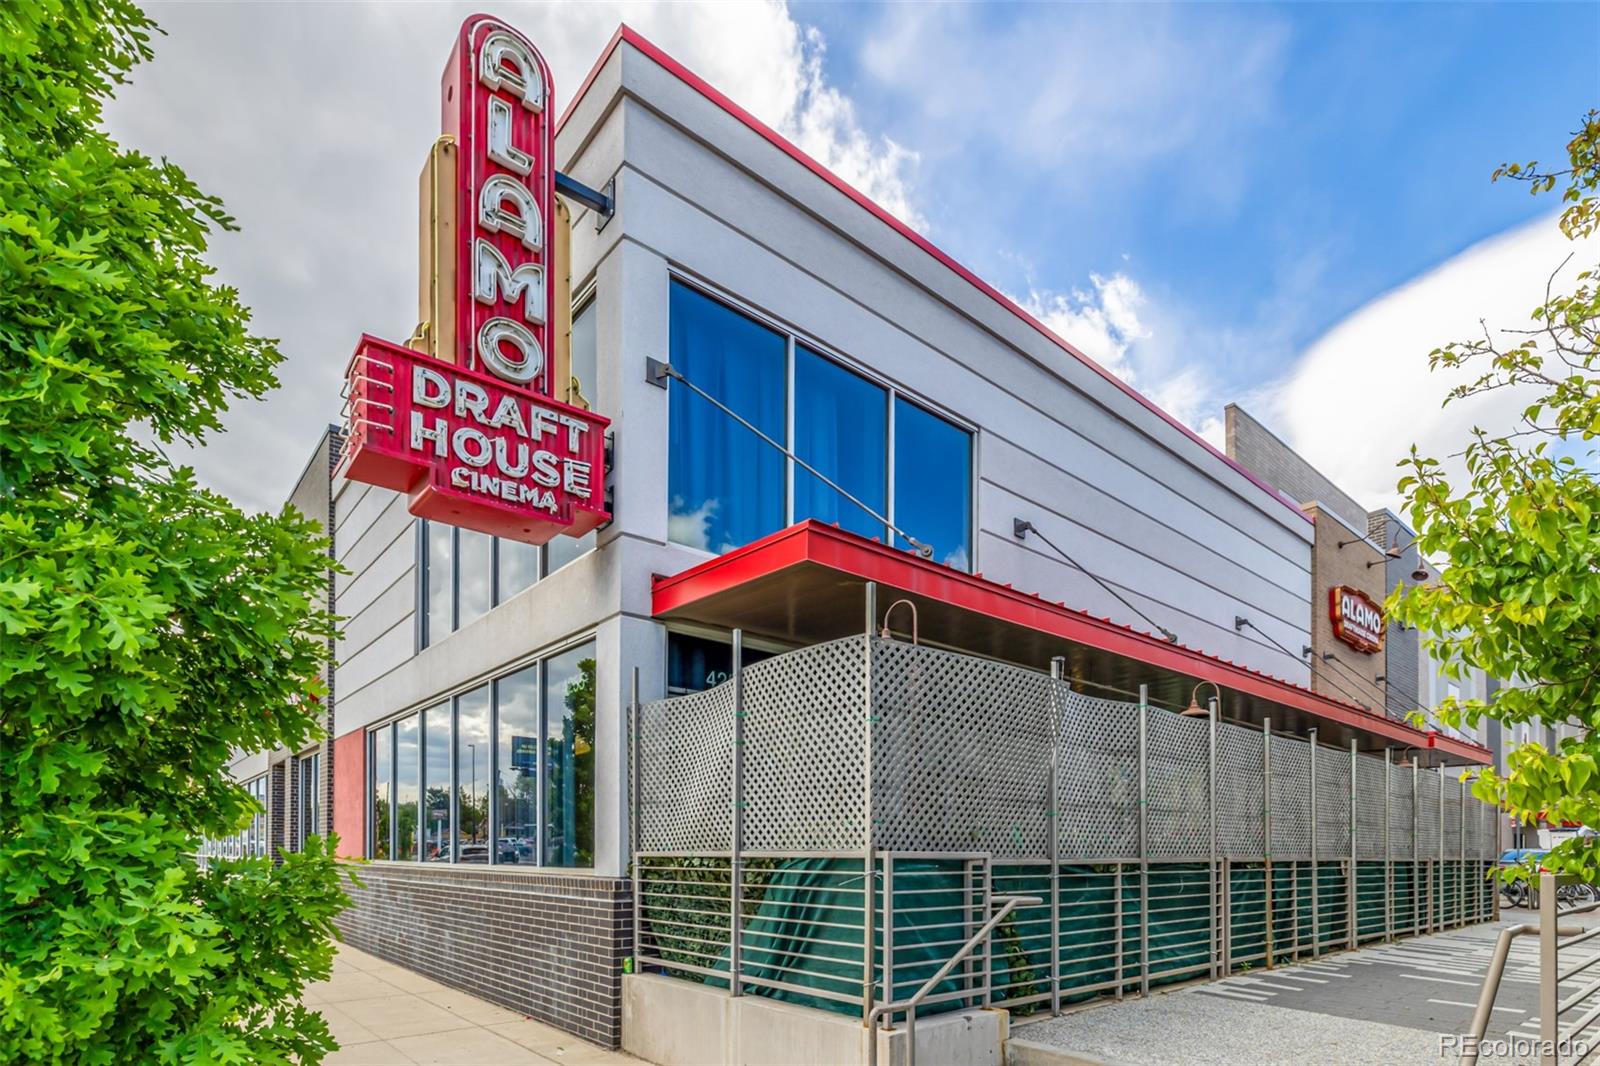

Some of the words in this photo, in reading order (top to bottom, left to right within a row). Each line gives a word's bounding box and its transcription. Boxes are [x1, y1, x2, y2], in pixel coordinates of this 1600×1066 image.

[474, 30, 546, 384] ALAMO
[412, 365, 590, 454] DRAFT
[410, 410, 593, 498] HOUSE
[451, 466, 559, 515] CINEMA
[1341, 595, 1381, 634] ALAMO
